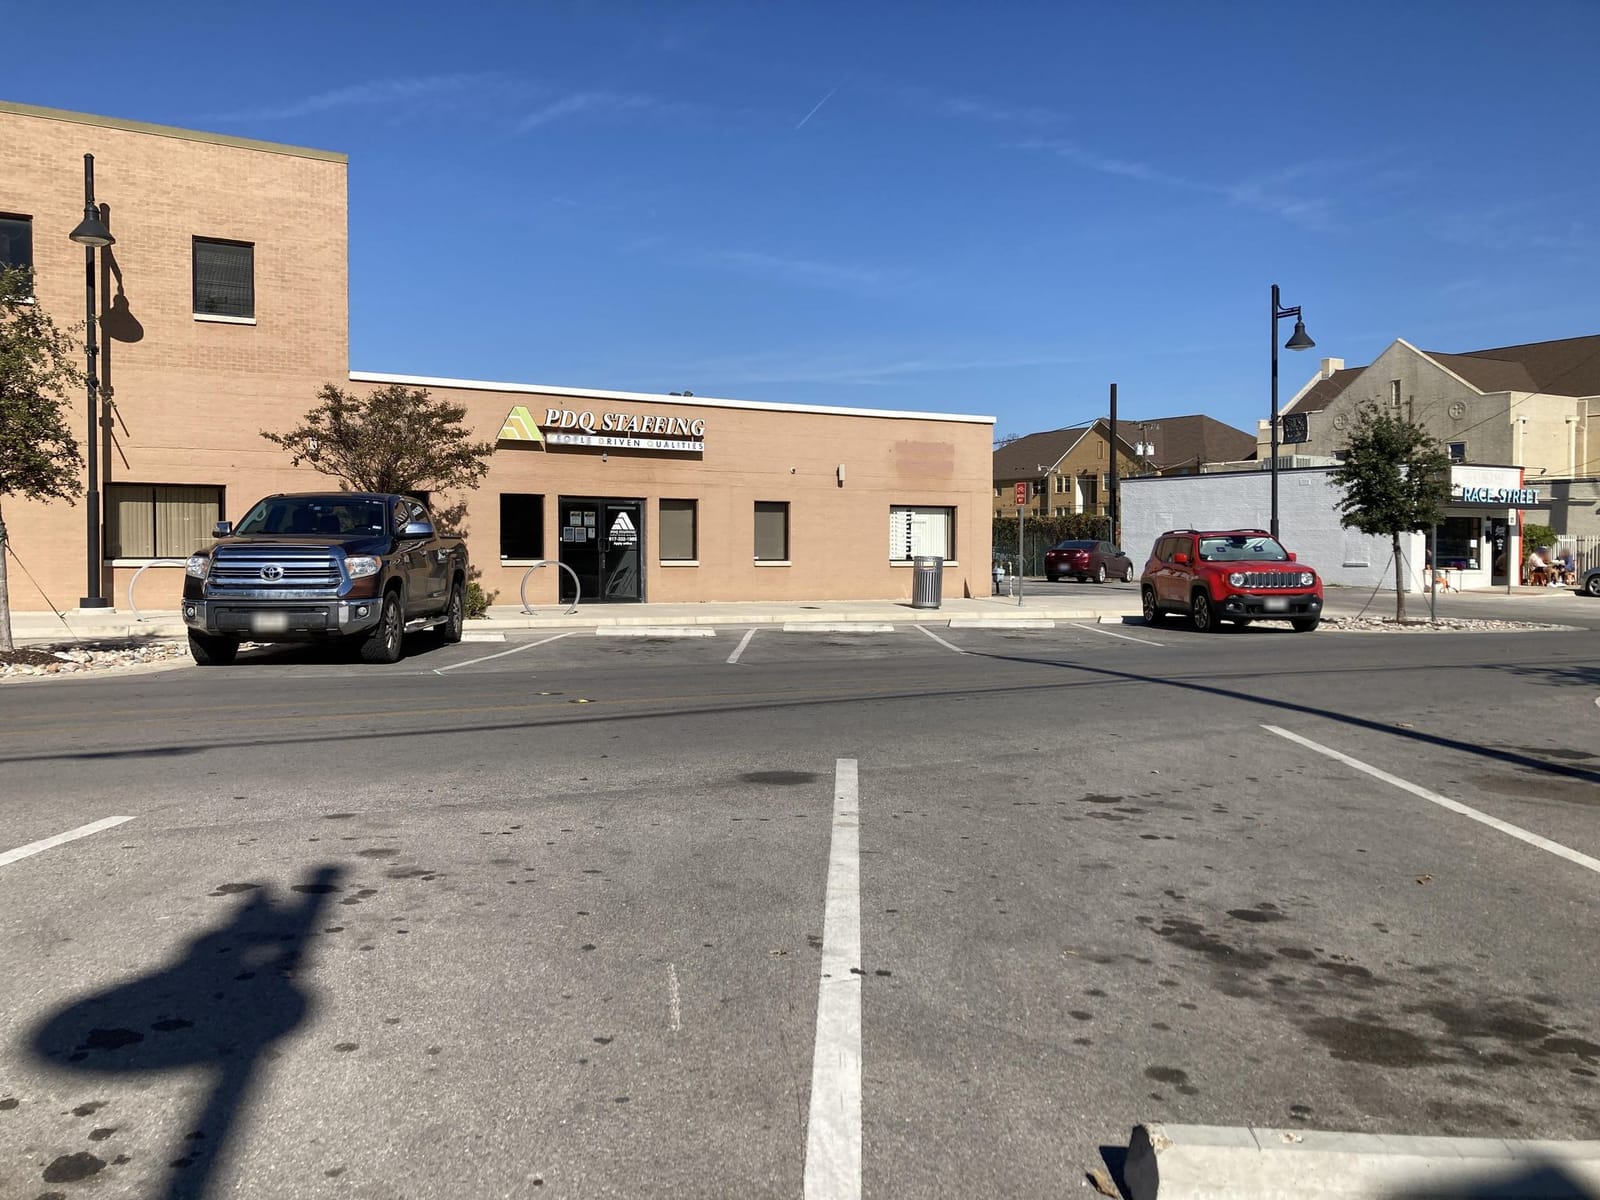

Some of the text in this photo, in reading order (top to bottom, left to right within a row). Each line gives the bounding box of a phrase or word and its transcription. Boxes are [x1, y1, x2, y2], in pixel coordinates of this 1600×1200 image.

[544, 408, 705, 436] PDQ STAFFING
[599, 437, 640, 447] DRIVEN
[647, 440, 704, 450] QUALITIES
[1463, 487, 1540, 504] RACE STREET
